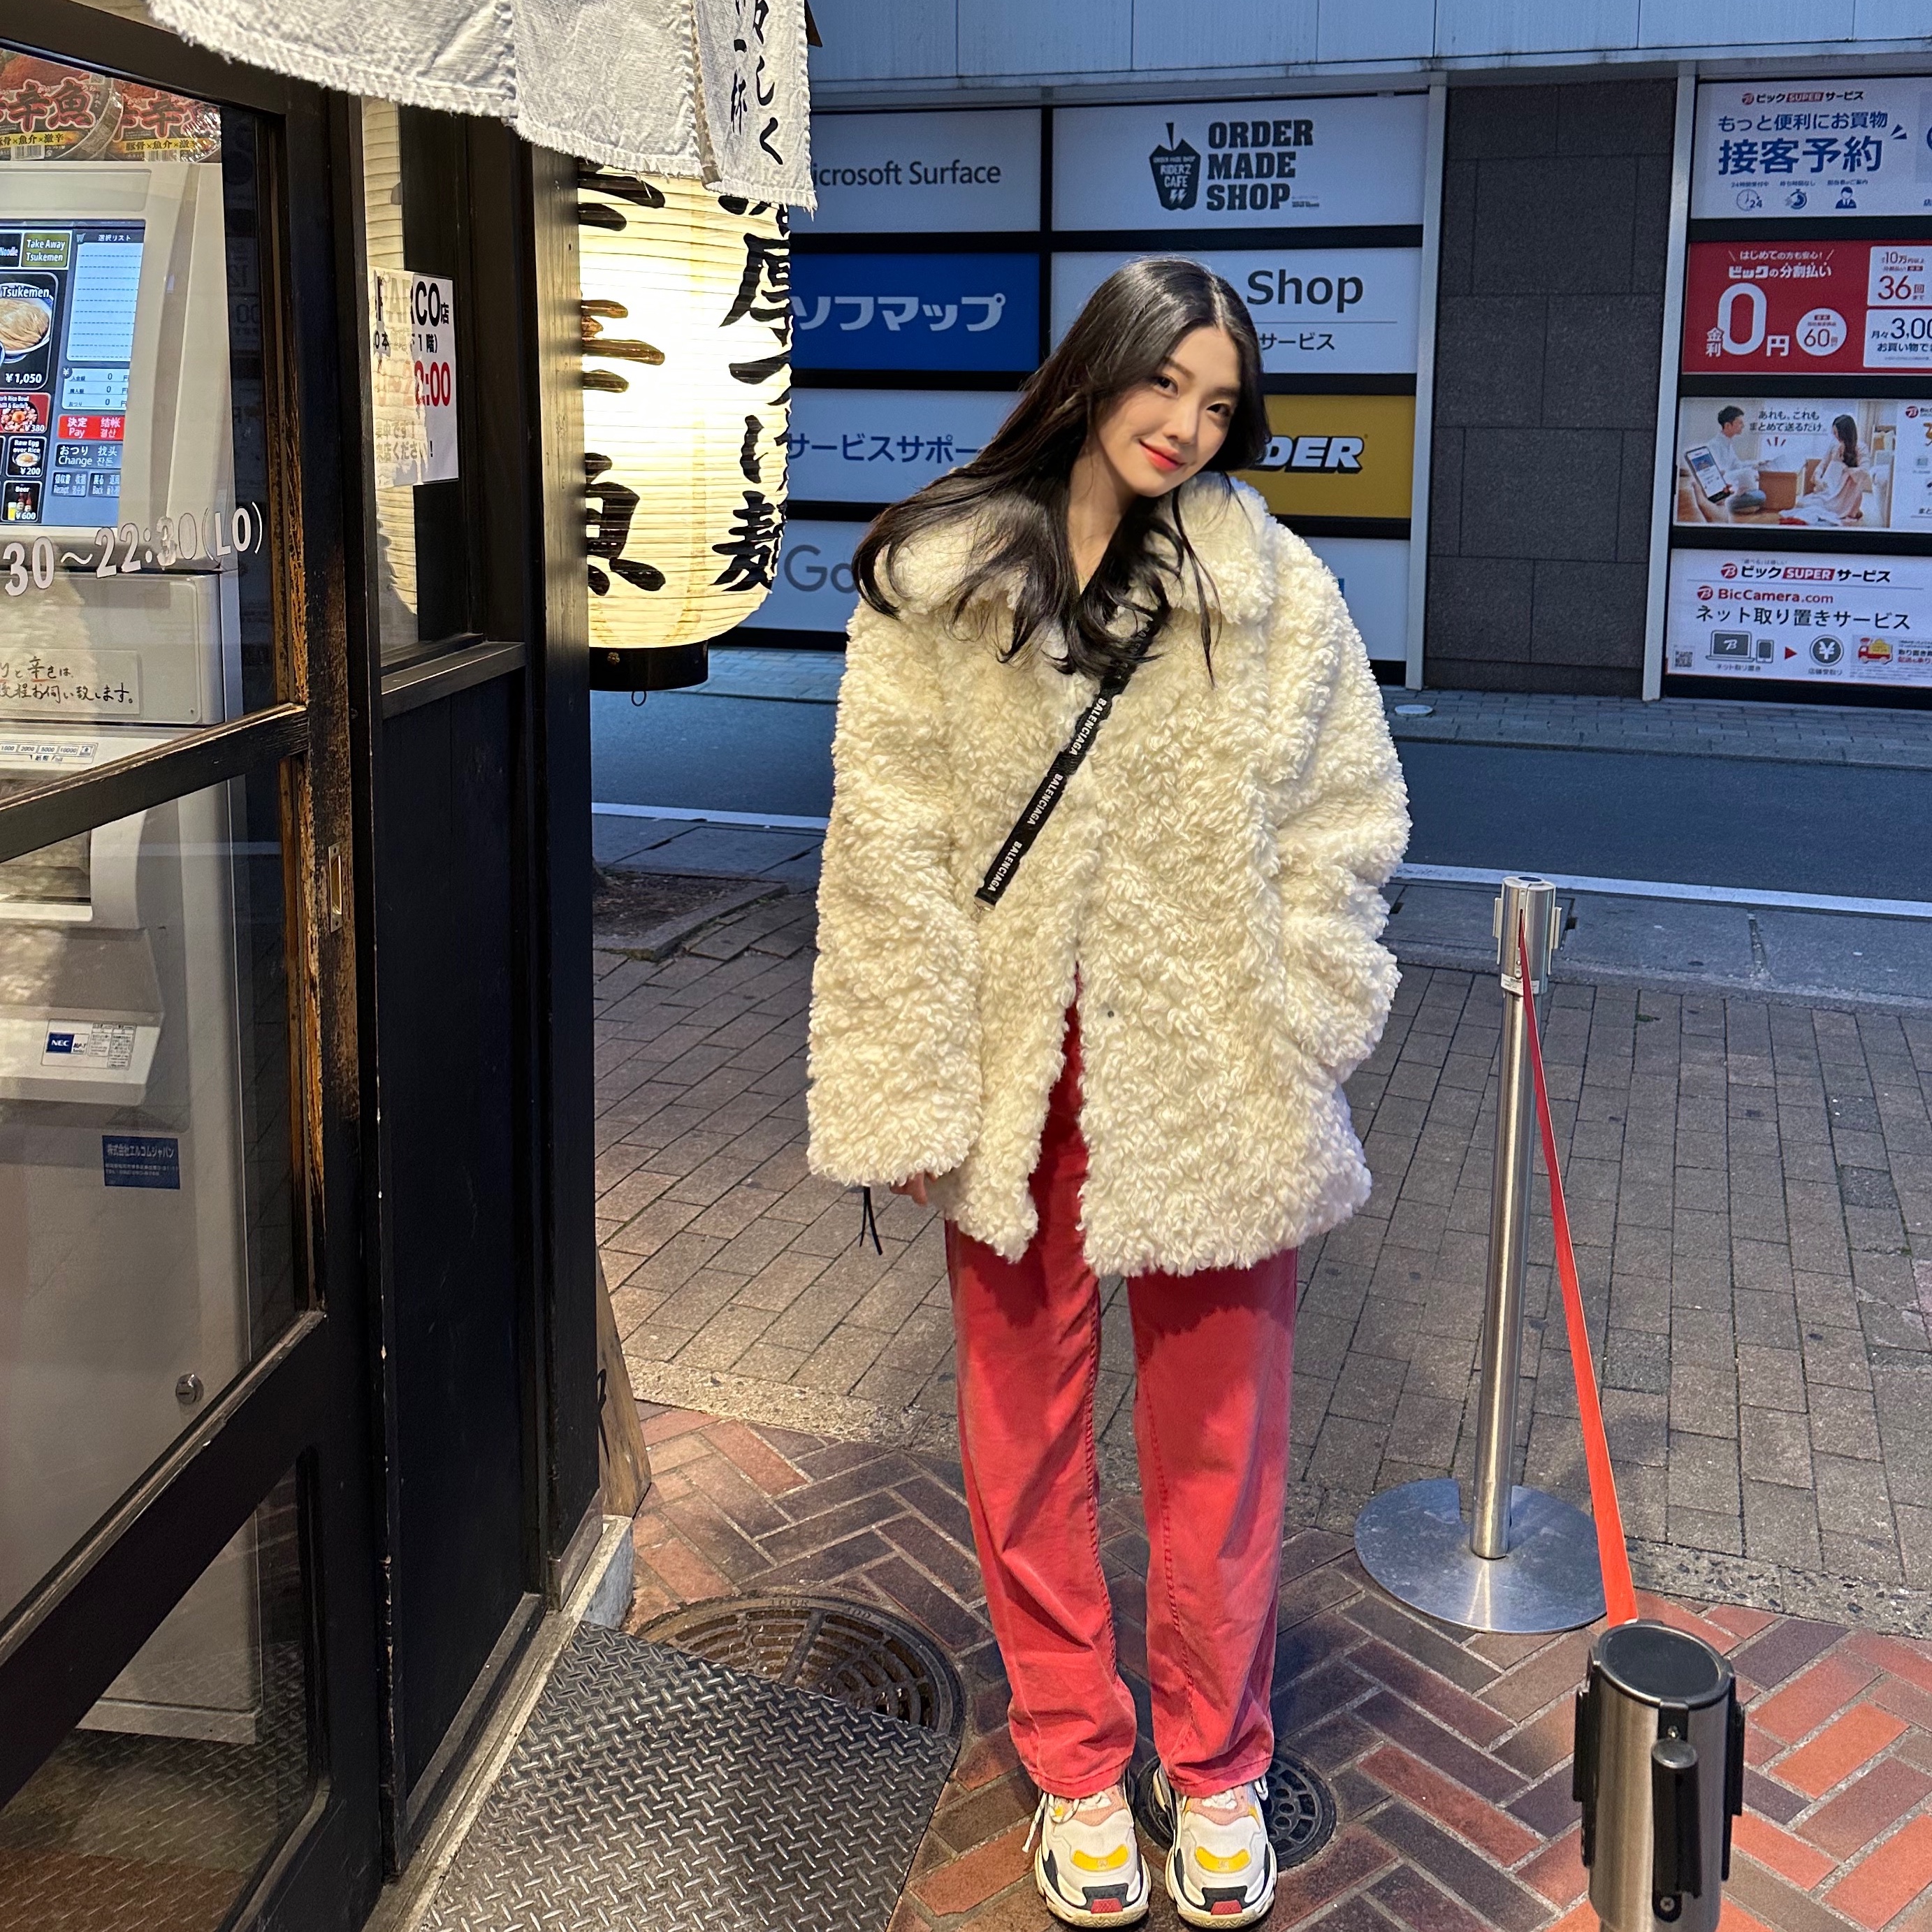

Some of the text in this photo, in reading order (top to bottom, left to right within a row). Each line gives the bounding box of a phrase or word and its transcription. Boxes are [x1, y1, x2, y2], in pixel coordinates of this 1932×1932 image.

[1208, 119, 1314, 149] ORDER
[1717, 110, 1889, 133] もっと便利にお買物
[1207, 151, 1297, 180] MADE
[1717, 135, 1883, 176] 接客予約
[811, 160, 1002, 187] icrosoft Surface
[1163, 175, 1189, 188] CAFE
[1206, 182, 1291, 212] SHOP
[25, 252, 64, 262] Tsukemen
[26, 239, 66, 252] Take Away
[1247, 269, 1363, 313] Shop
[790, 292, 1006, 332] ソフマップ
[67, 417, 88, 428] 決定
[68, 428, 85, 439] Pay
[58, 456, 93, 467] Change
[59, 445, 89, 456] おつり
[1256, 435, 1364, 474] DER
[20, 467, 41, 475] ¥200
[1717, 588, 1834, 604] BicCamera.com
[1696, 604, 1912, 630] ネット取り置きサービス
[1068, 697, 1107, 756] BALENCIAGA
[1026, 773, 1063, 826] BALENCIAGA
[987, 841, 1023, 892] BALENCIAGA
[51, 1039, 70, 1047] NEC
